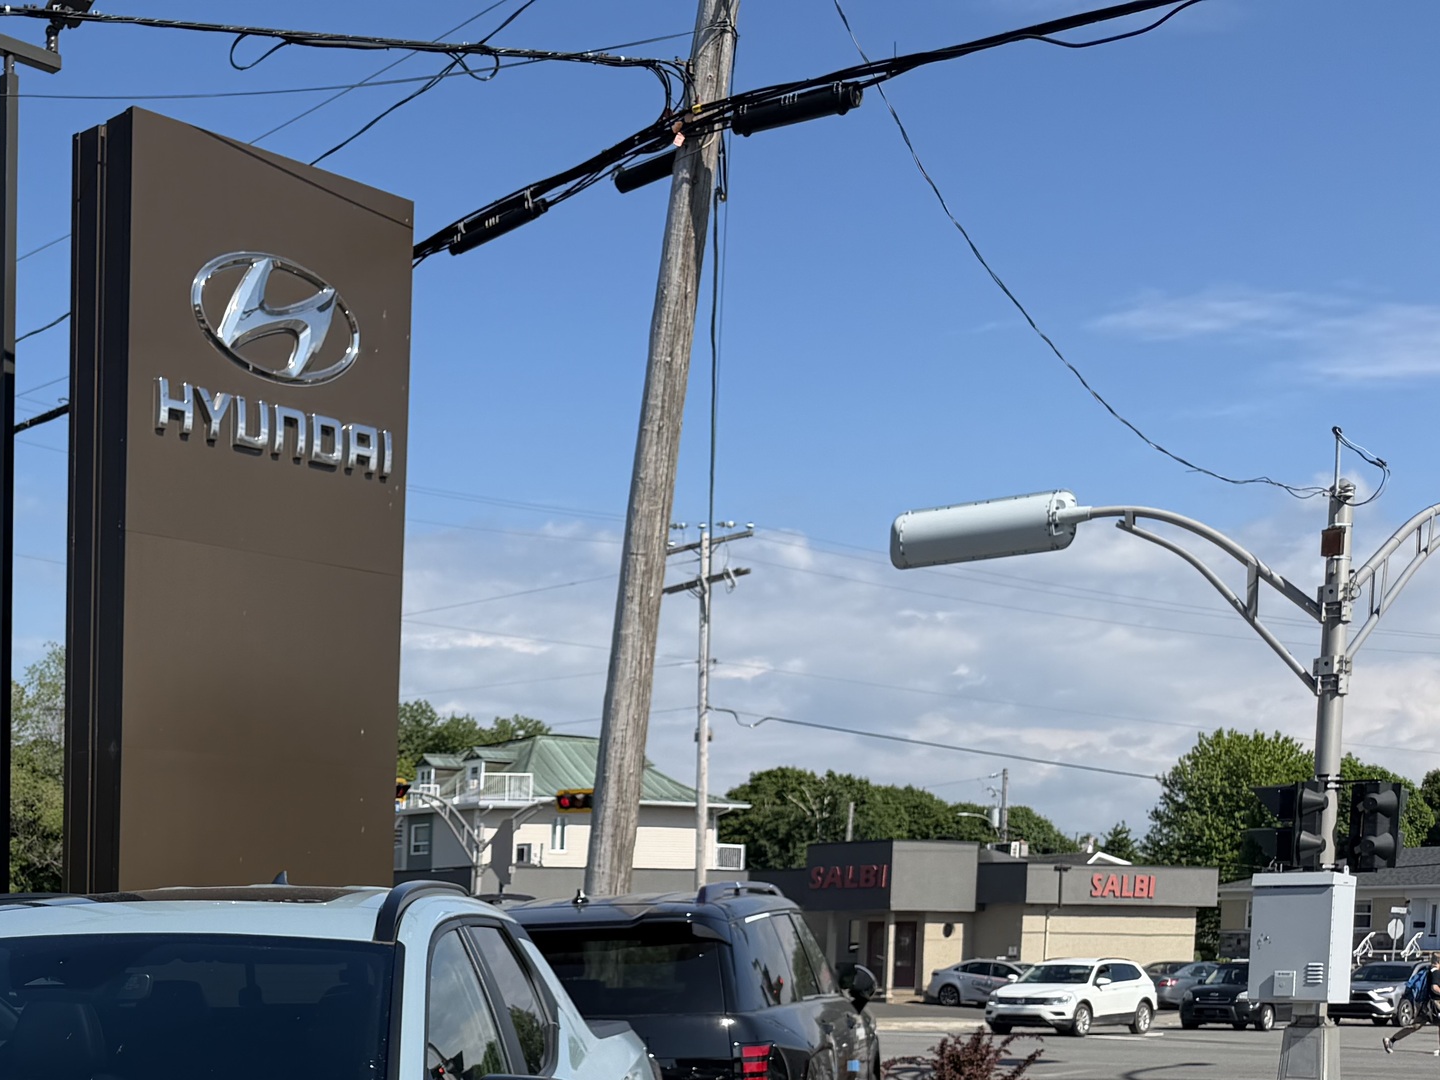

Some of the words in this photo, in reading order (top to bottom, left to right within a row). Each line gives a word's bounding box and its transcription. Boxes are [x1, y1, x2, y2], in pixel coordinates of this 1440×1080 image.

[156, 377, 392, 481] HYUNDAI
[809, 864, 888, 889] SALBI
[1090, 872, 1157, 898] SALBI
